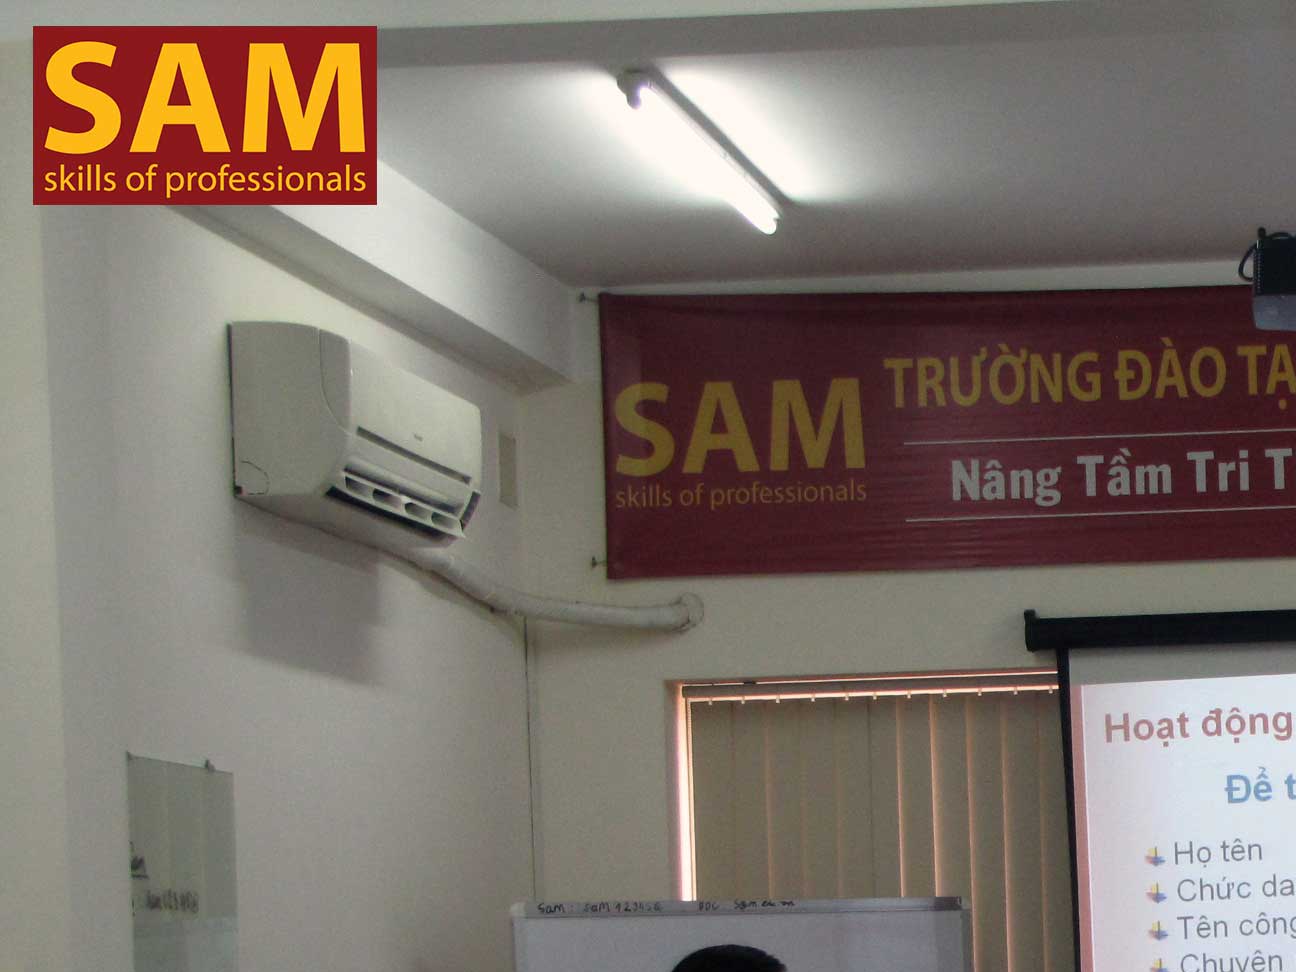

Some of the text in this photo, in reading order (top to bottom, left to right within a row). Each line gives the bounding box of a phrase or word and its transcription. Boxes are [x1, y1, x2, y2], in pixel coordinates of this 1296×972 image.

[884, 344, 1099, 408] TRƯỜNG
[1114, 337, 1226, 399] ĐÀO
[615, 377, 866, 477] SAM
[615, 478, 867, 511] skills of professionals
[951, 459, 1062, 507] Nâng
[1077, 449, 1172, 498] Tầm
[1187, 449, 1249, 494] Tri
[1105, 711, 1190, 747] Hoạt
[1201, 707, 1293, 743] động
[1224, 766, 1273, 804] Để
[1174, 838, 1263, 868] Họ tên
[1177, 876, 1252, 902] Chức
[1176, 915, 1229, 940] Tên
